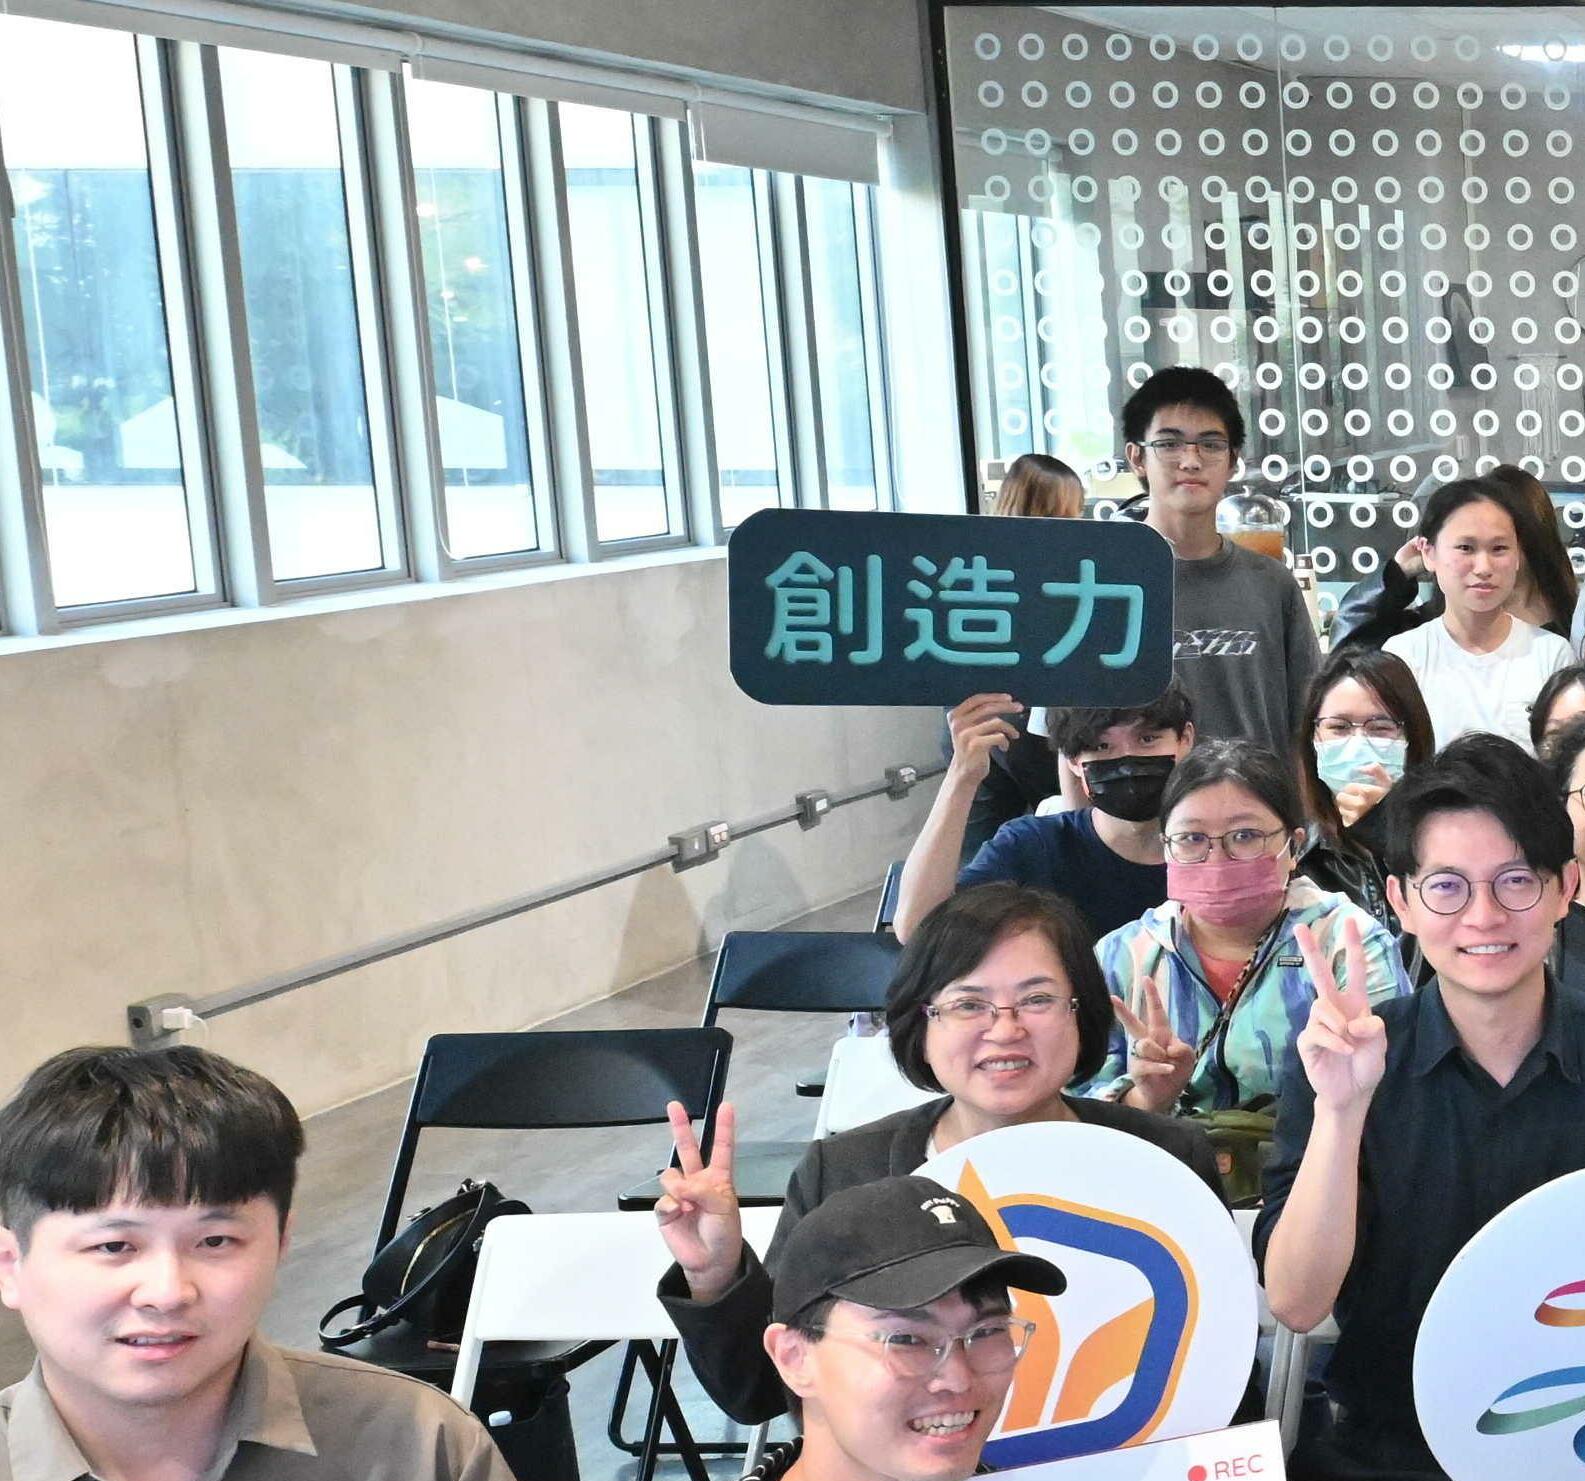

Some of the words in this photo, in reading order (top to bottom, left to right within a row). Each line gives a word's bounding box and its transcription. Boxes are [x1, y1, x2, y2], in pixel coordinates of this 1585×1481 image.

[764, 550, 1144, 669] 創造力
[1213, 1454, 1264, 1480] REC
